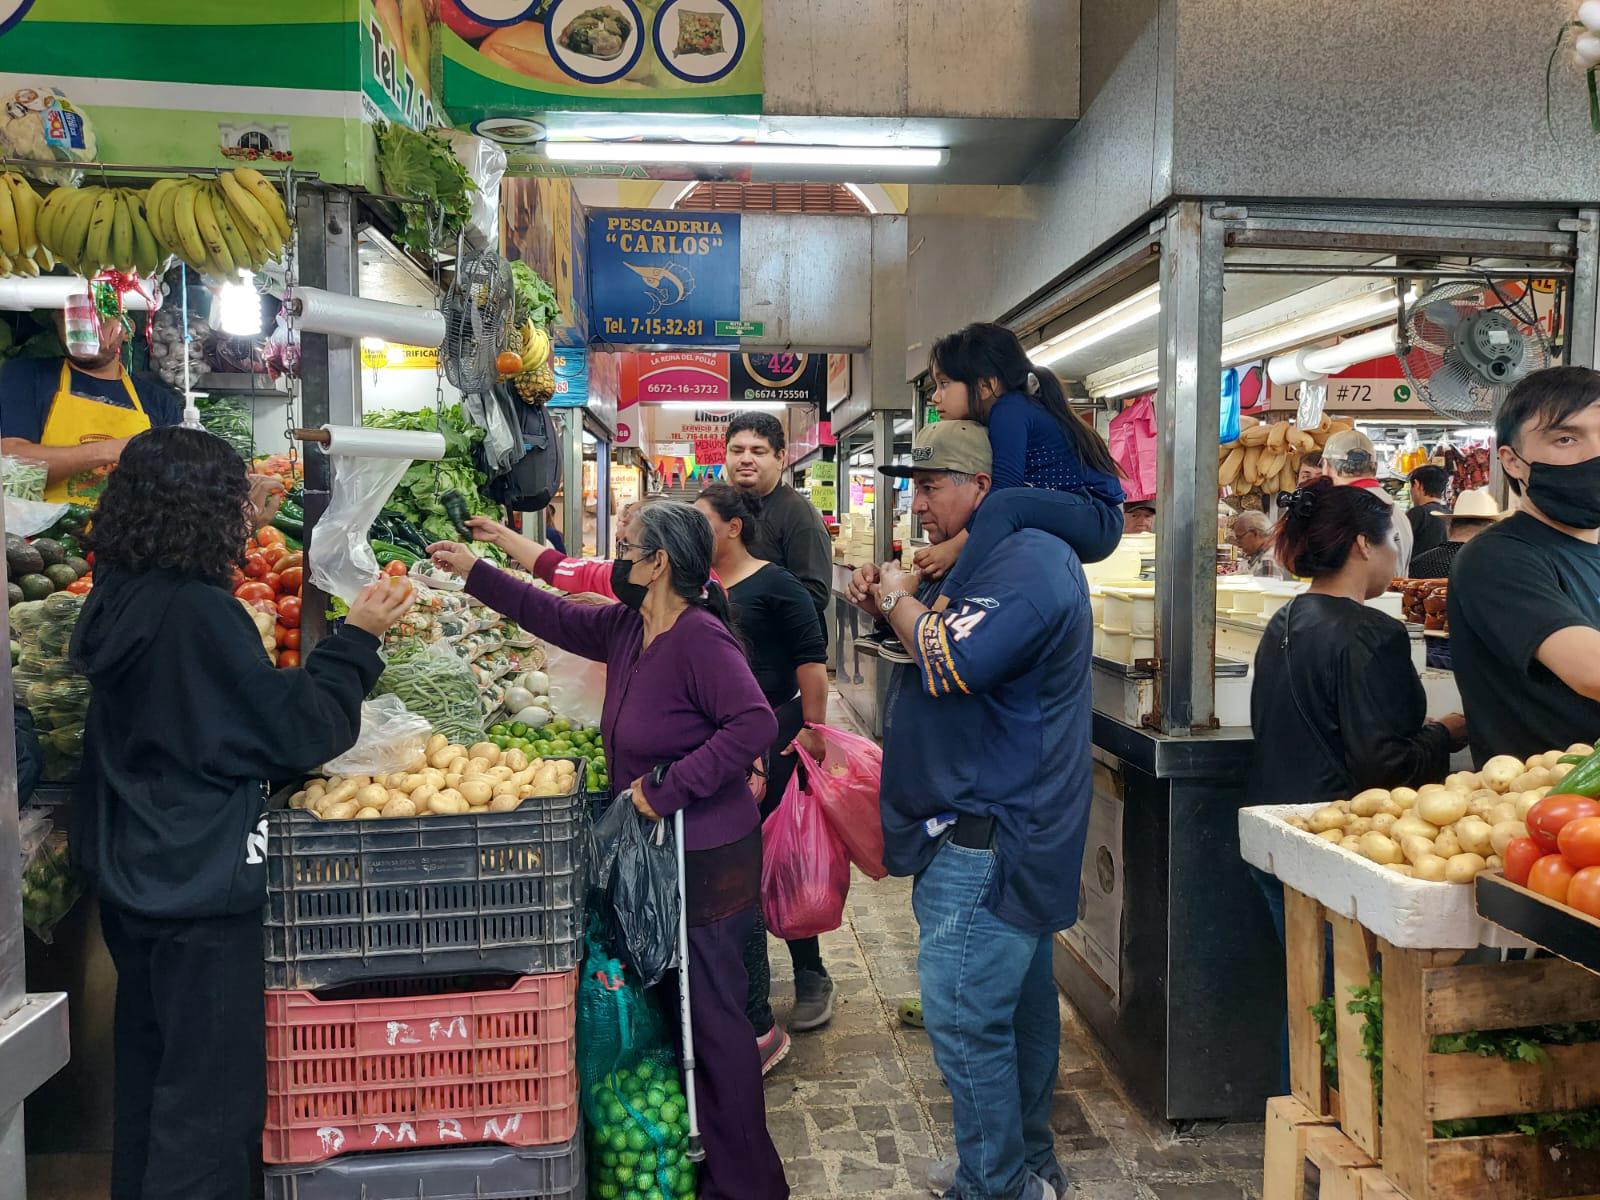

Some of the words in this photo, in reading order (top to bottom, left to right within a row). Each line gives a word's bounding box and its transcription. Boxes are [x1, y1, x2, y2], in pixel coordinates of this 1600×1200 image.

[370, 14, 402, 113] Tel.
[607, 217, 723, 235] PESCADERIA
[603, 317, 627, 334] Tel.
[650, 357, 660, 366] LA
[681, 353, 694, 361] DEL
[767, 351, 794, 374] 42
[647, 383, 719, 394] 6672-16-3732
[755, 390, 776, 399] 6674
[778, 390, 809, 399] 755501
[1336, 385, 1372, 402] #72
